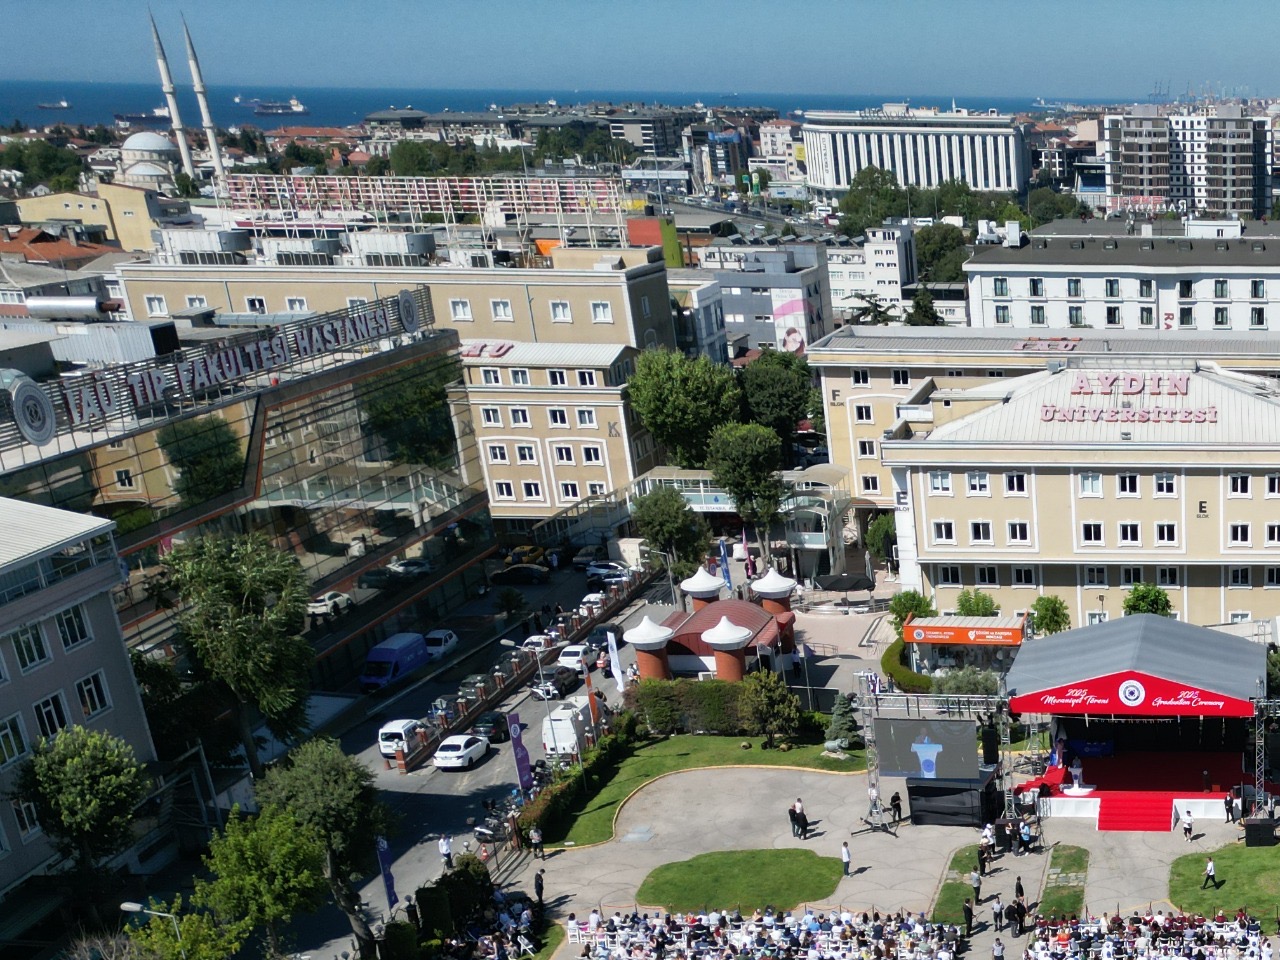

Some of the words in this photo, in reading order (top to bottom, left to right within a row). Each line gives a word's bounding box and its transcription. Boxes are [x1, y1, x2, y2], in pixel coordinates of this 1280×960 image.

[128, 369, 166, 406] TIP
[1071, 373, 1190, 396] AYDIN
[831, 389, 841, 401] F
[1040, 402, 1218, 424] ÜNİVERSİTESİ
[1198, 500, 1208, 513] E
[1065, 689, 1089, 697] 2025
[1177, 690, 1200, 698] 2025
[1040, 695, 1083, 707] Mezuniyet
[1084, 695, 1109, 705] Töreni
[1152, 697, 1190, 708] Graduation
[1191, 698, 1224, 709] Ceremony
